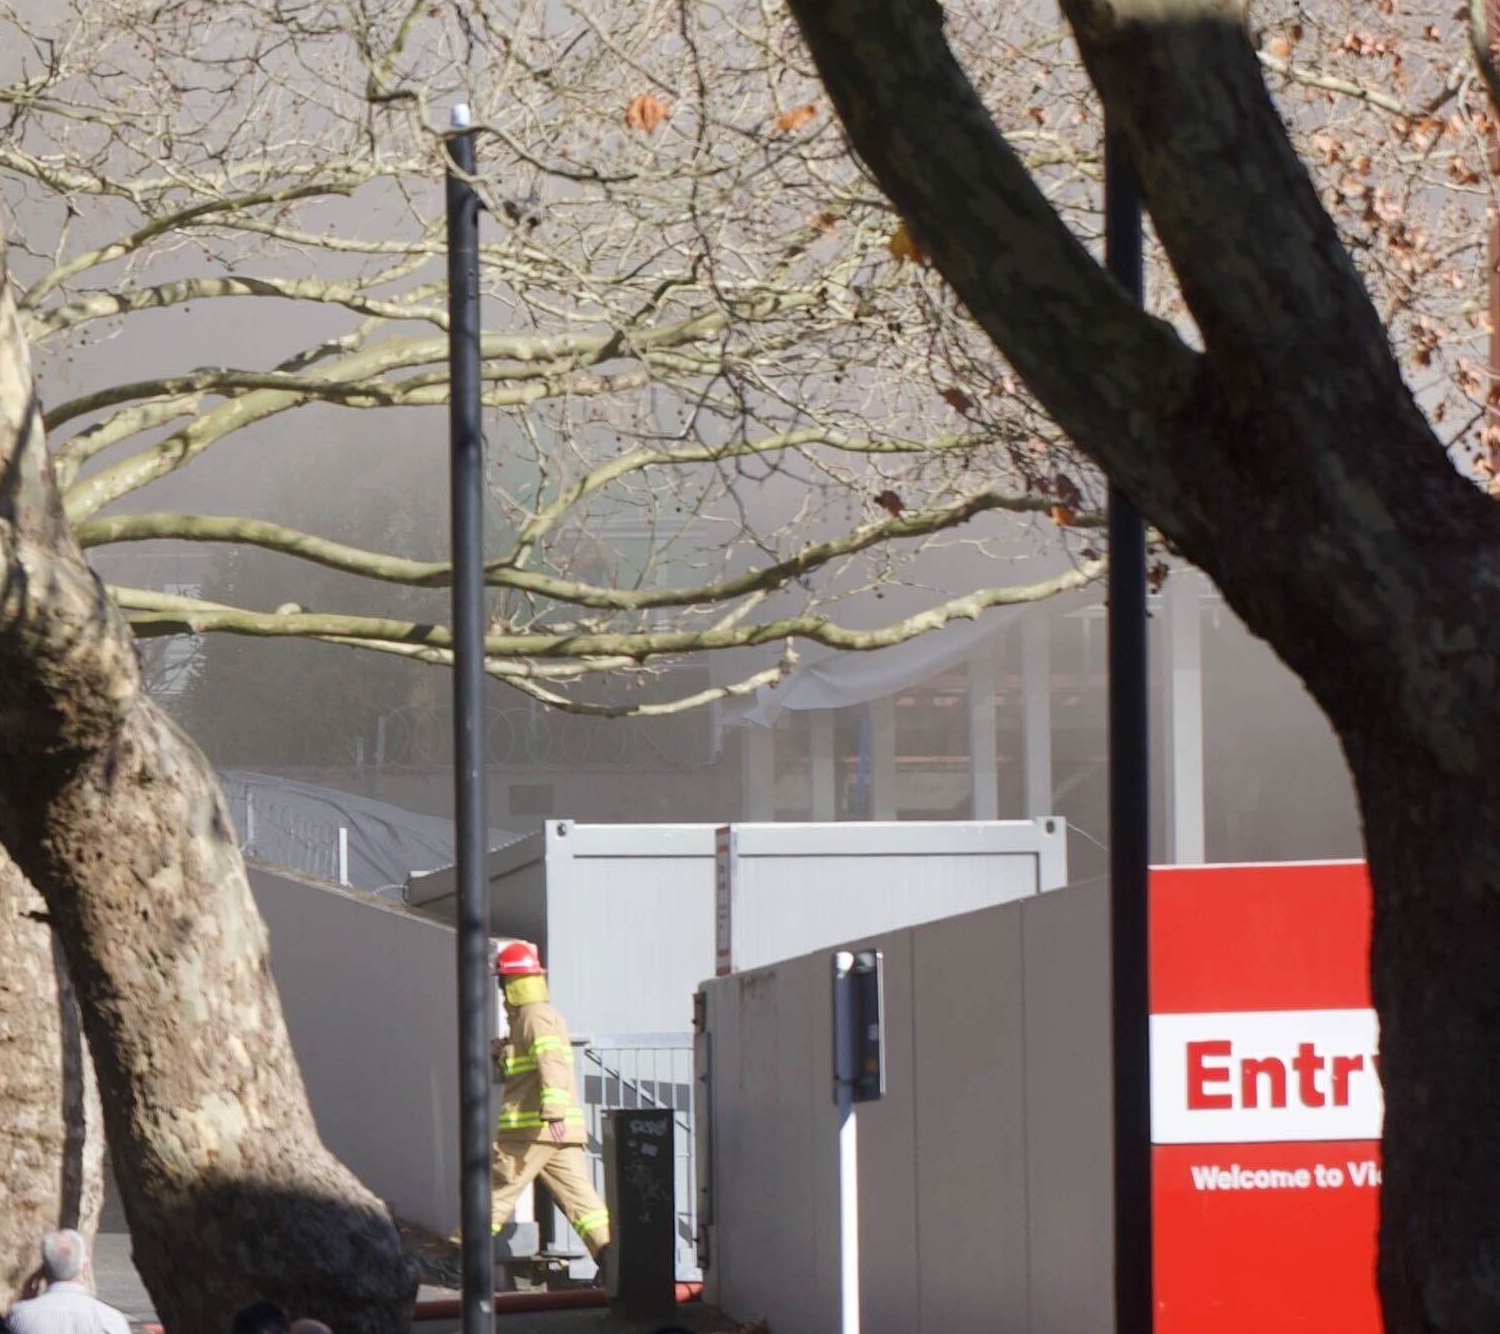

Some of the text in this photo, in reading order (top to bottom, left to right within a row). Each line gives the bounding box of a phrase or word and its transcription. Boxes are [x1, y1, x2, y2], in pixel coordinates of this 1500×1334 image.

[1186, 1040, 1380, 1110] Entr
[1190, 1162, 1312, 1191] Welcome
[1314, 1164, 1343, 1189] to
